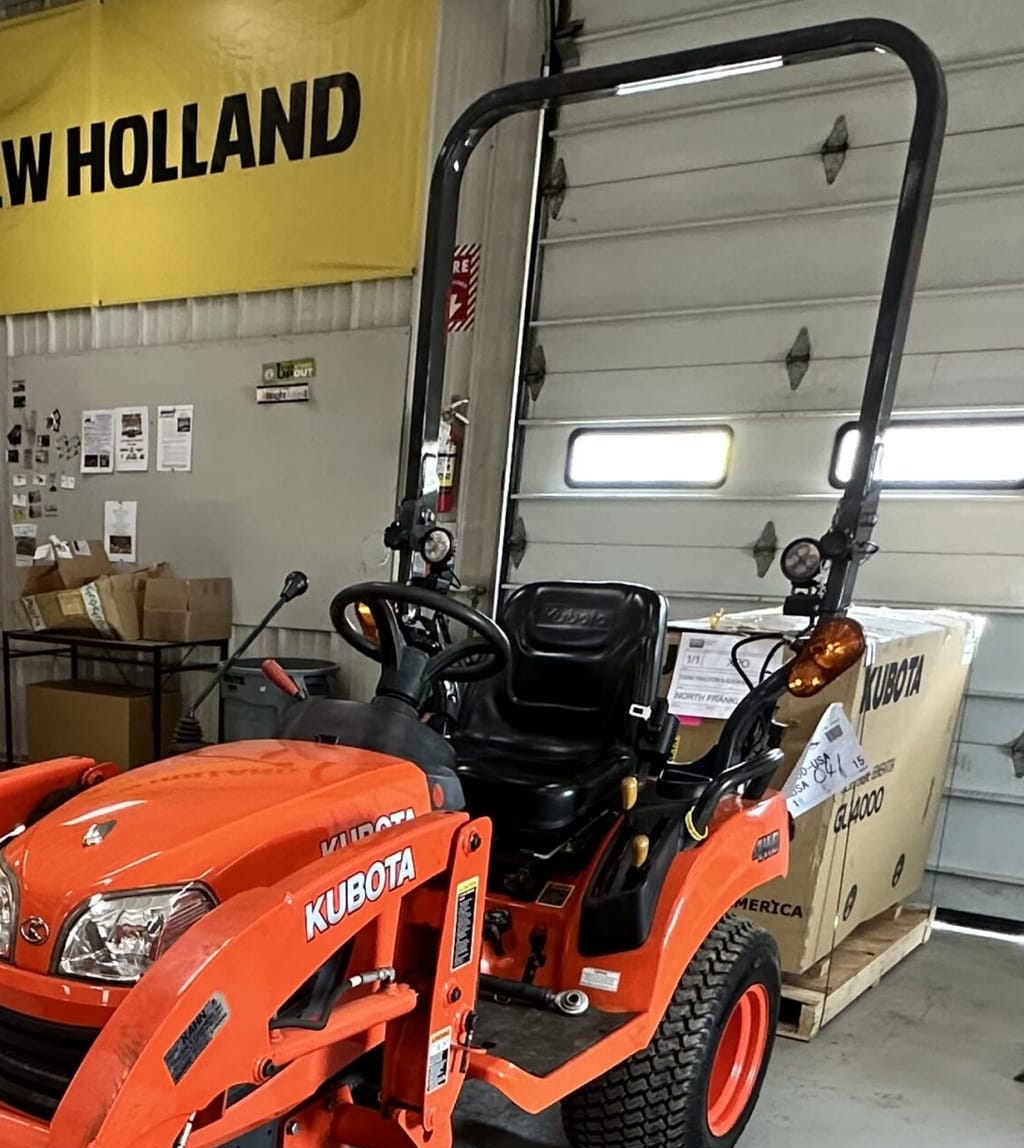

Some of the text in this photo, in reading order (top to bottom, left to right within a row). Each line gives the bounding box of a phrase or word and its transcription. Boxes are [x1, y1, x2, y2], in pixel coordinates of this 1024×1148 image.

[66, 71, 361, 197] HOLLAND
[452, 259, 470, 274] RE
[859, 654, 924, 714] KUBOTA
[852, 757, 865, 769] 15
[304, 845, 416, 944] KUBOTA
